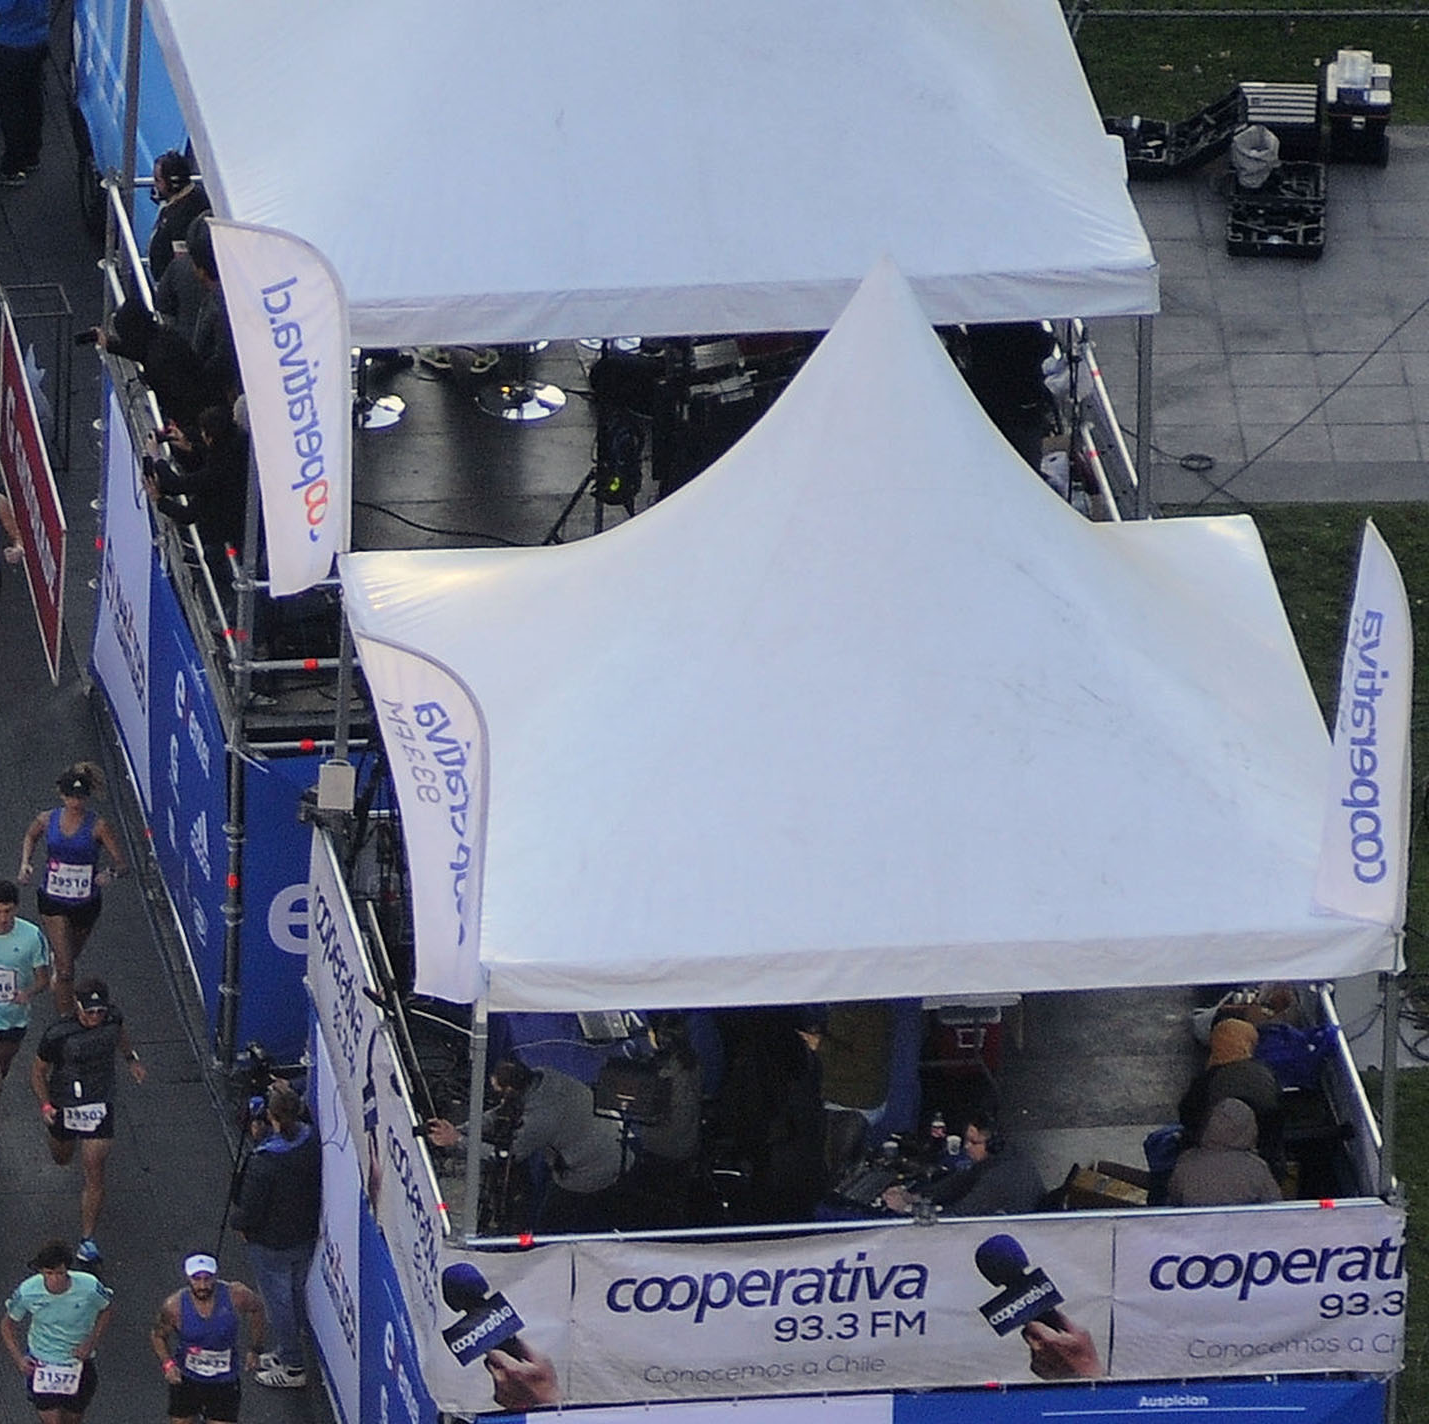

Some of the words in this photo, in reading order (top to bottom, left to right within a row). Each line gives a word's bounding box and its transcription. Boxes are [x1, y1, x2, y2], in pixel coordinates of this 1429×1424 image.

[606, 1252, 930, 1323] cooperativa
[990, 1282, 1056, 1327] cooperativa
[1320, 1291, 1405, 1320] 93.3
[450, 1305, 514, 1354] cooperativa
[774, 1314, 861, 1343] 93.3
[871, 1310, 927, 1338] FM
[1188, 1338, 1340, 1360] Conocemos
[1348, 1337, 1364, 1352] a
[644, 1363, 795, 1386] Conocemos
[803, 1362, 820, 1376] a
[827, 1354, 886, 1374] Chile
